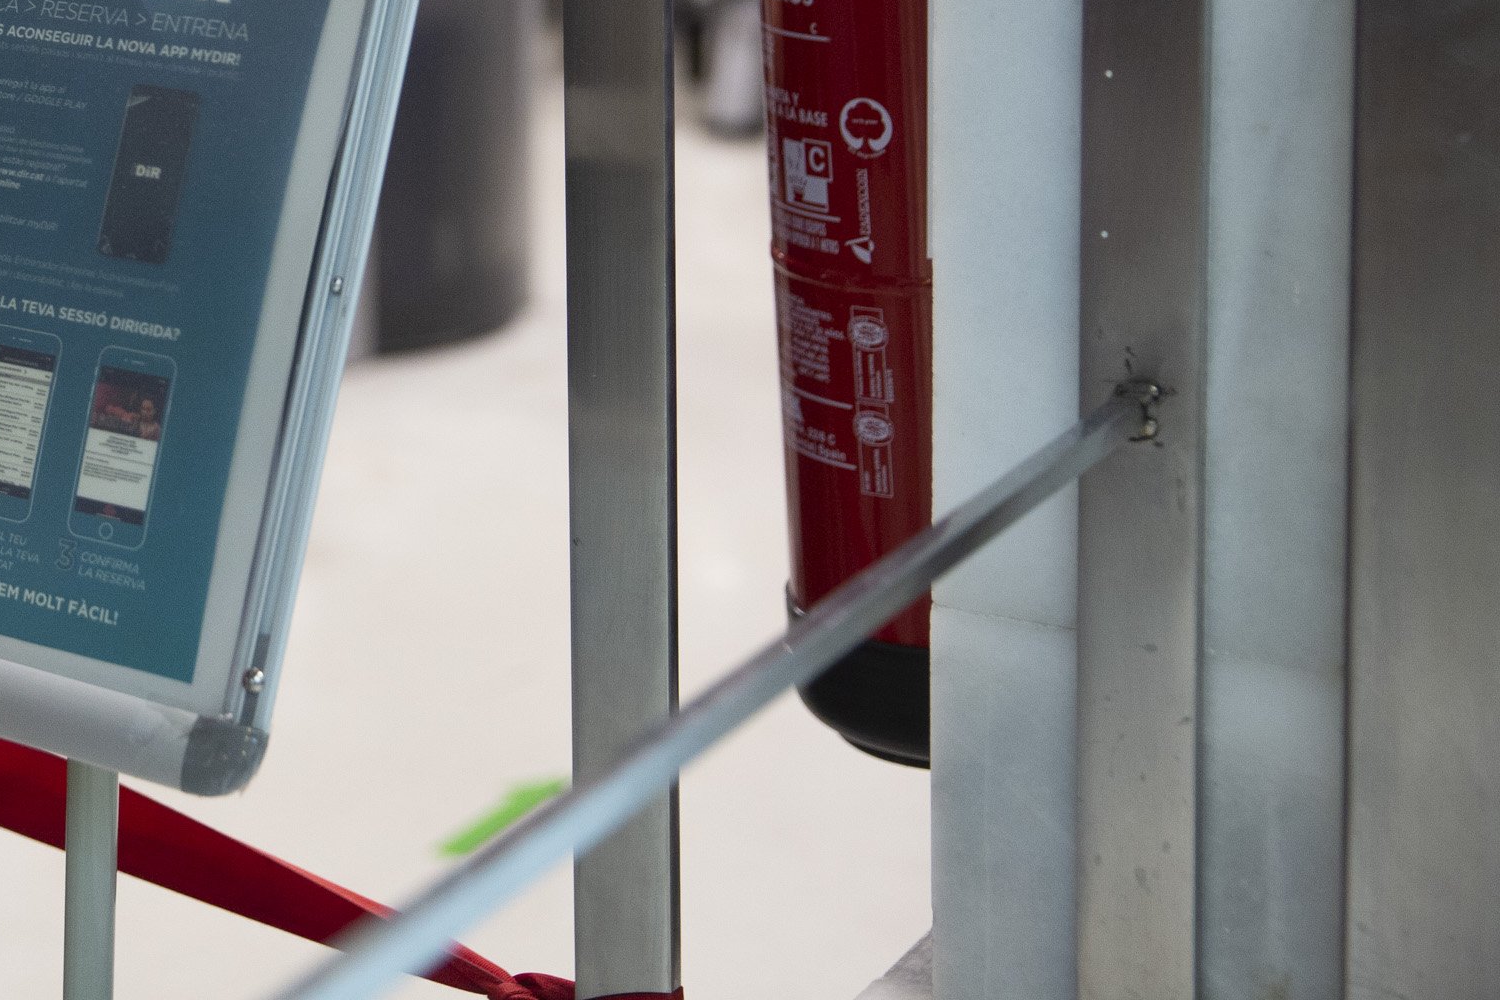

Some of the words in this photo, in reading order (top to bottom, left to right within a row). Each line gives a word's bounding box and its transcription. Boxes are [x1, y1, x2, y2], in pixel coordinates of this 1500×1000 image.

[150, 12, 249, 42] ENTRENA
[6, 25, 93, 47] ACONSEGUIR
[96, 36, 114, 50] LA
[117, 40, 156, 56] NOVA
[159, 45, 189, 60] APP
[190, 48, 241, 66] MYDIR!
[22, 93, 63, 107] GOOGLE
[798, 107, 828, 128] BASE
[135, 164, 162, 180] DiR
[808, 145, 825, 173] C
[0, 294, 17, 310] LA
[20, 298, 56, 318] TEVA
[59, 306, 107, 328] SESSIÓ
[110, 317, 181, 341] DIRIGIDA?
[9, 533, 27, 546] TEU
[1, 544, 14, 557] LA
[16, 548, 40, 564] TEVA
[53, 538, 78, 571] 3
[80, 550, 140, 575] CONFIRMA
[77, 565, 93, 578] LA
[95, 568, 146, 591] RESERVA
[22, 588, 65, 612] MOLT
[67, 597, 119, 626] FÀCIL!
